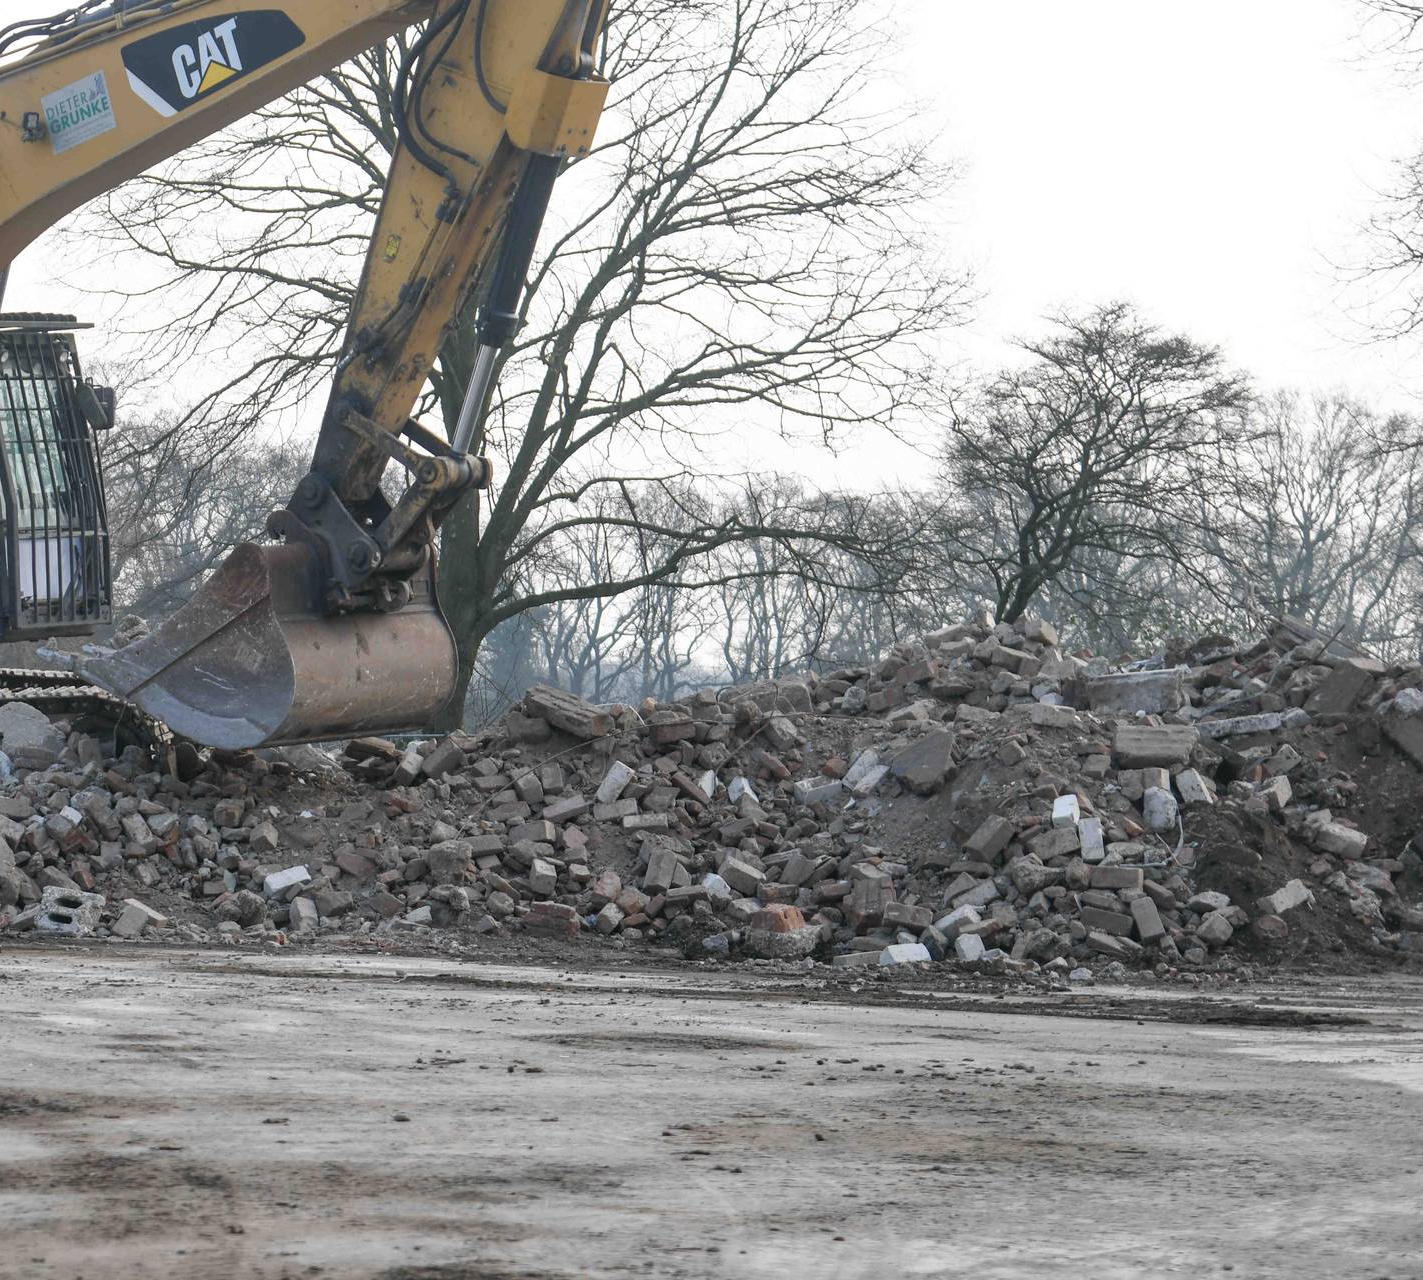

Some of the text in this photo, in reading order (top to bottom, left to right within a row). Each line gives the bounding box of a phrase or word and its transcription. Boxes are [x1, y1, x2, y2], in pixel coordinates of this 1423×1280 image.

[172, 17, 243, 98] CAT
[45, 91, 88, 121] DIETER
[50, 96, 109, 134] GRUNKE
